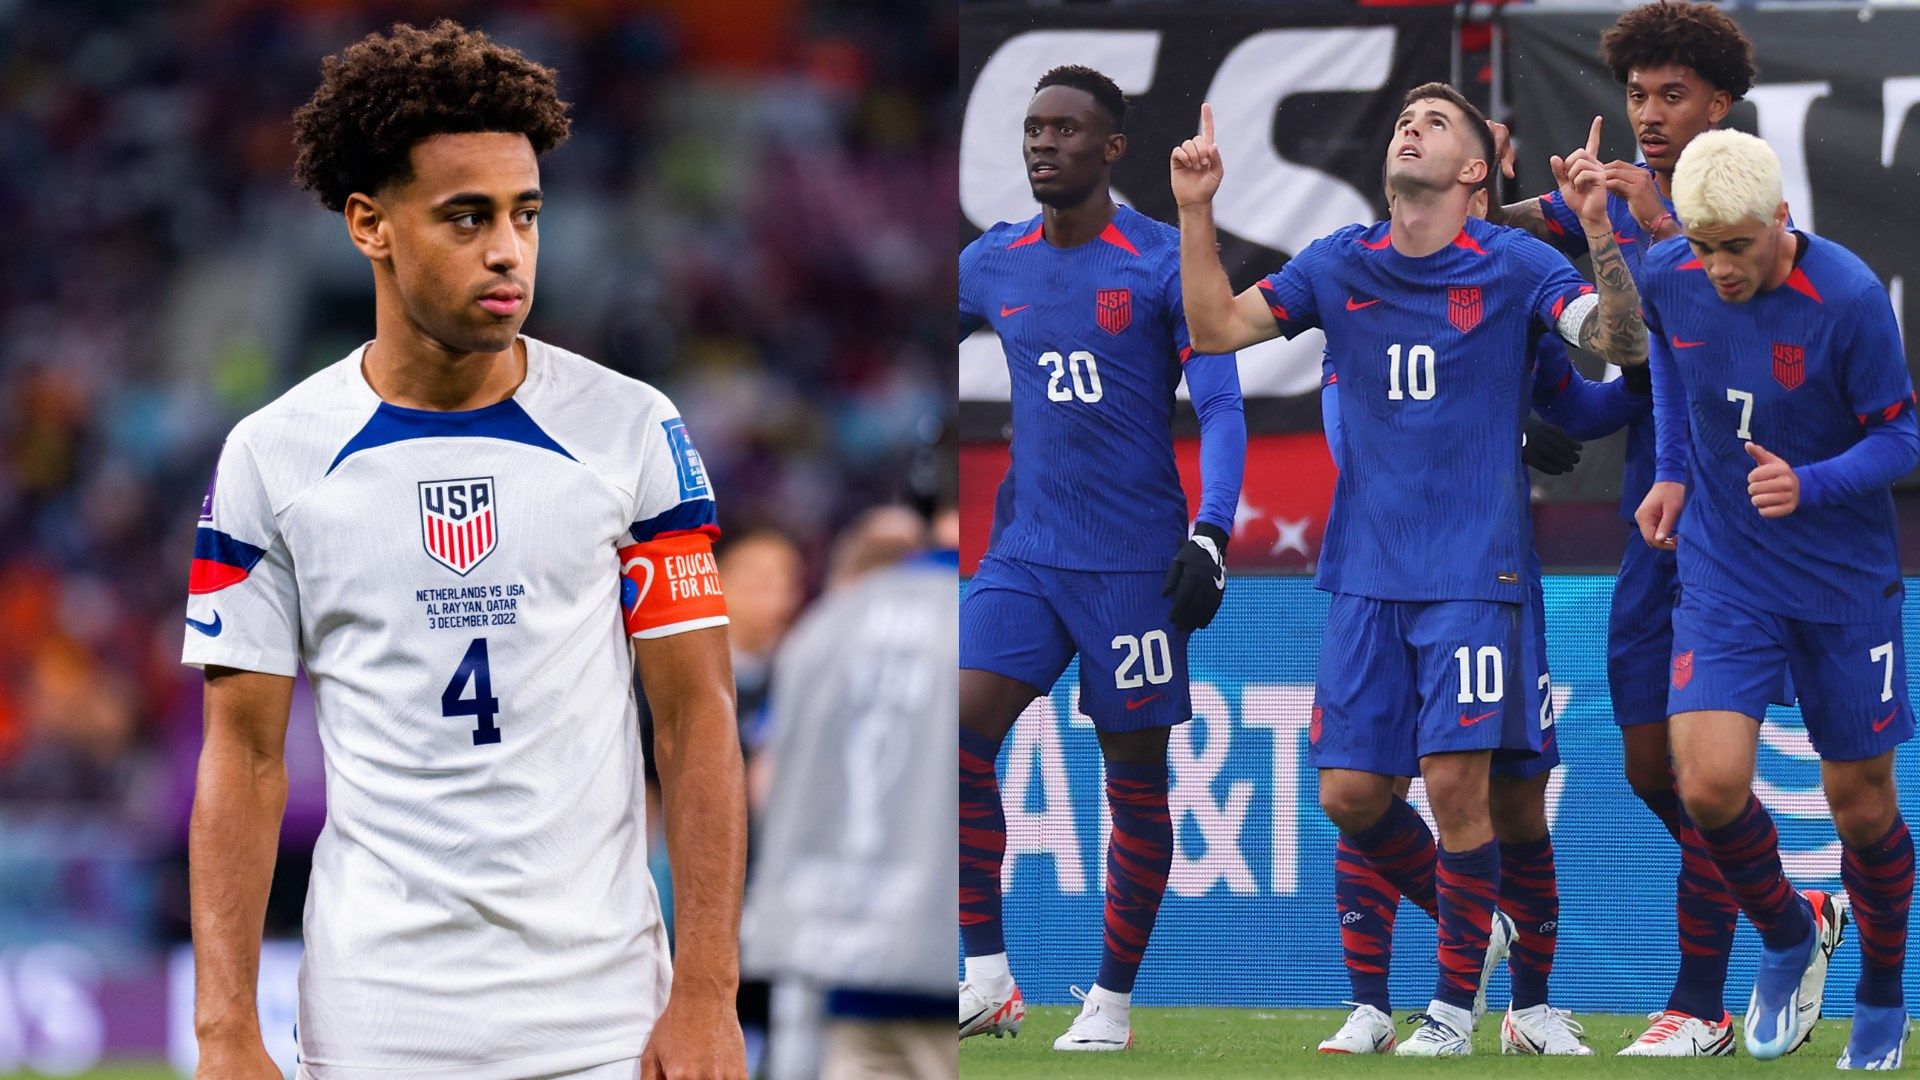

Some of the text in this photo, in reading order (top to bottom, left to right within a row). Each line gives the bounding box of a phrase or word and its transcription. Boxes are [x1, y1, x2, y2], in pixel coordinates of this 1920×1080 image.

[1097, 291, 1129, 308] USA
[1449, 287, 1480, 307] USA
[1038, 350, 1103, 403] 20
[1387, 343, 1436, 400] 10
[1774, 344, 1803, 364] USA
[1726, 388, 1753, 440] 7
[425, 483, 489, 521] USA
[416, 584, 525, 602] NETHERLANDS VS USA
[426, 603, 440, 615] AL
[486, 598, 517, 612] QATAR
[670, 575, 723, 601] FOR ALL
[429, 612, 516, 629] 3 DECEMBER 2022
[1111, 629, 1173, 690] 20
[1454, 645, 1504, 703] 10
[1869, 640, 1894, 703] 7
[441, 637, 502, 746] 4
[1537, 672, 1552, 730] 2
